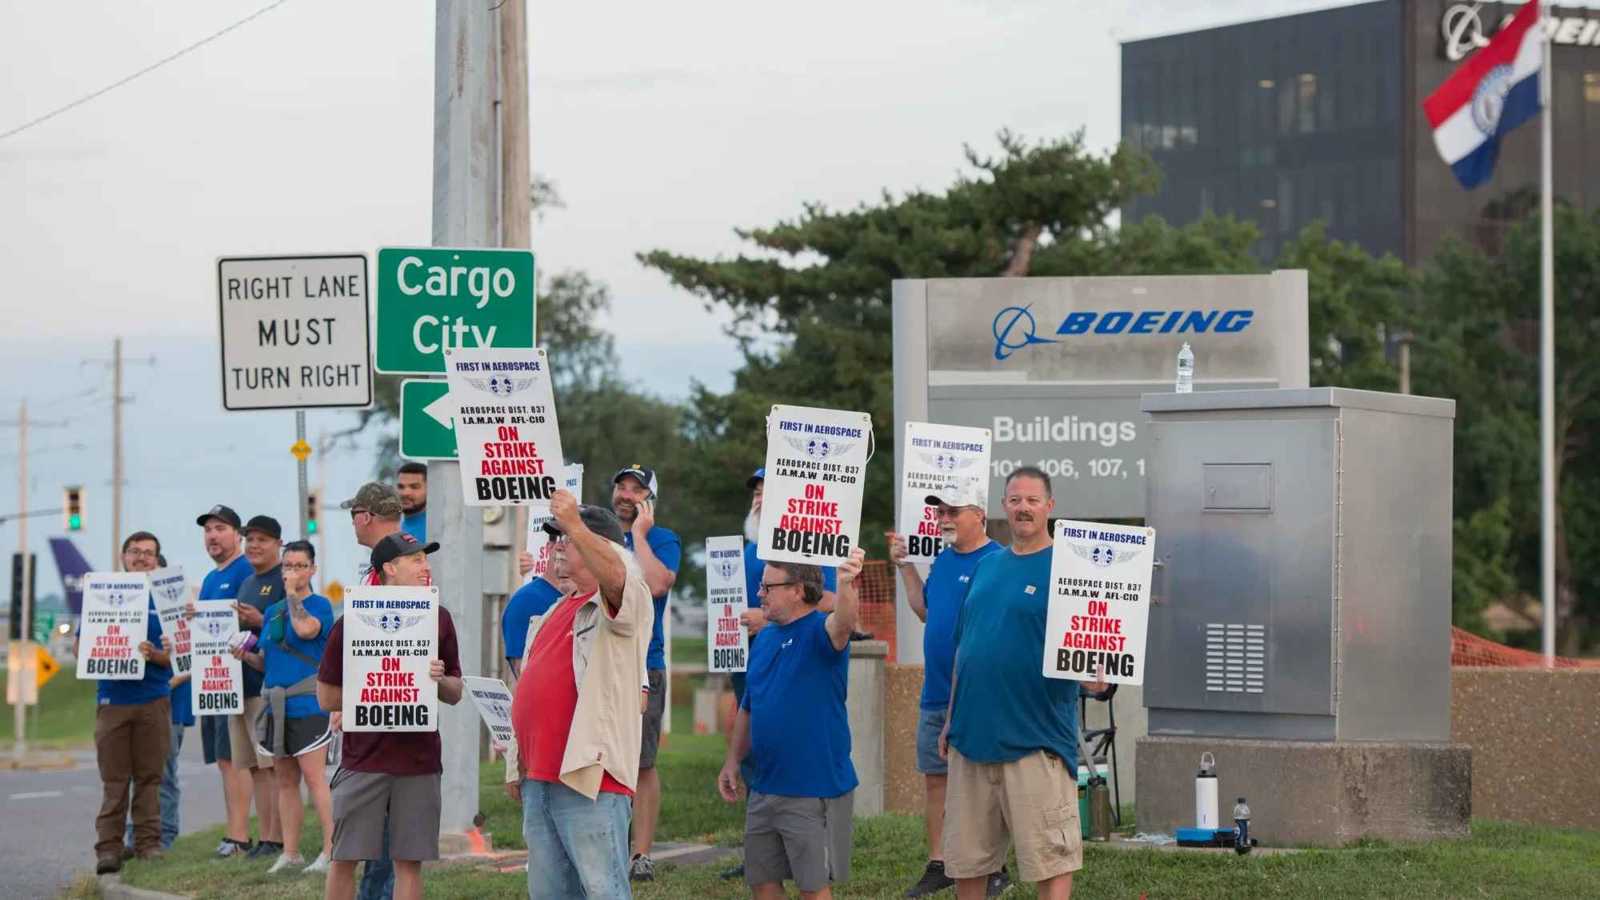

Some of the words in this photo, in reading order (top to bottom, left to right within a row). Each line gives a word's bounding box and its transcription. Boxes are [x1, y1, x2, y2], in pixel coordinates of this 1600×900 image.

[228, 276, 292, 300] RIGHT
[304, 275, 360, 298] LANE
[397, 256, 516, 309] Cargo
[1056, 310, 1254, 334] BOEING
[258, 318, 336, 346] MUST
[412, 315, 498, 354] City
[456, 361, 480, 372] FIRST
[482, 361, 491, 372] IN
[492, 361, 541, 372] AEROSPACE
[232, 366, 290, 390] TURN
[301, 364, 362, 388] RIGHT
[460, 406, 506, 415] AEROSPACE
[508, 406, 529, 414] DIST.
[510, 416, 546, 424] AFL-CIO
[498, 426, 519, 442] ON
[780, 420, 803, 432] FIRST
[804, 422, 814, 433] IN
[814, 425, 862, 438] AEROSPACE
[993, 416, 1136, 447] Buildings
[484, 442, 537, 458] STRIKE
[912, 437, 932, 448] FIRST
[933, 439, 942, 448] IN
[942, 441, 984, 452] AEROSPACE
[481, 459, 544, 476] AGAINST
[776, 458, 820, 471] AEROSPACE
[823, 463, 844, 473] DIST.
[1088, 458, 1128, 478] 107,
[822, 473, 856, 484] AFL-CIO
[476, 476, 556, 501] BOEING
[804, 483, 824, 500] ON
[788, 498, 838, 518] STRIKE
[780, 514, 843, 535] AGAINST
[772, 528, 850, 558] BOEING
[1064, 528, 1087, 538] FIRST
[1088, 529, 1098, 540] IN
[1099, 531, 1146, 546] AEROSPACE
[1058, 577, 1103, 589] AEROSPACE
[1105, 581, 1125, 590] DIST.
[1127, 582, 1142, 592] 837
[1105, 591, 1139, 601] AFL-CIO
[352, 600, 374, 609] FIRST
[376, 600, 384, 609] IN
[386, 600, 431, 610] AEROSPACE
[724, 604, 732, 617] ON
[1088, 600, 1108, 616] ON
[106, 624, 120, 635] ON
[718, 618, 738, 632] STRIKE
[1071, 616, 1121, 634] STRIKE
[96, 636, 130, 646] STRIKE
[716, 632, 740, 646] AGAINST
[1064, 632, 1126, 652] AGAINST
[90, 647, 132, 658] AGAINST
[714, 648, 744, 668] BOEING
[86, 658, 139, 674] BOEING
[212, 656, 222, 666] ON
[382, 658, 400, 672] ON
[204, 668, 229, 678] STRIKE
[366, 672, 414, 686] STRIKE
[202, 680, 232, 691] AGAINST
[199, 692, 238, 710] BOEING
[360, 688, 420, 703] AGAINST
[355, 705, 428, 726] BOEING
